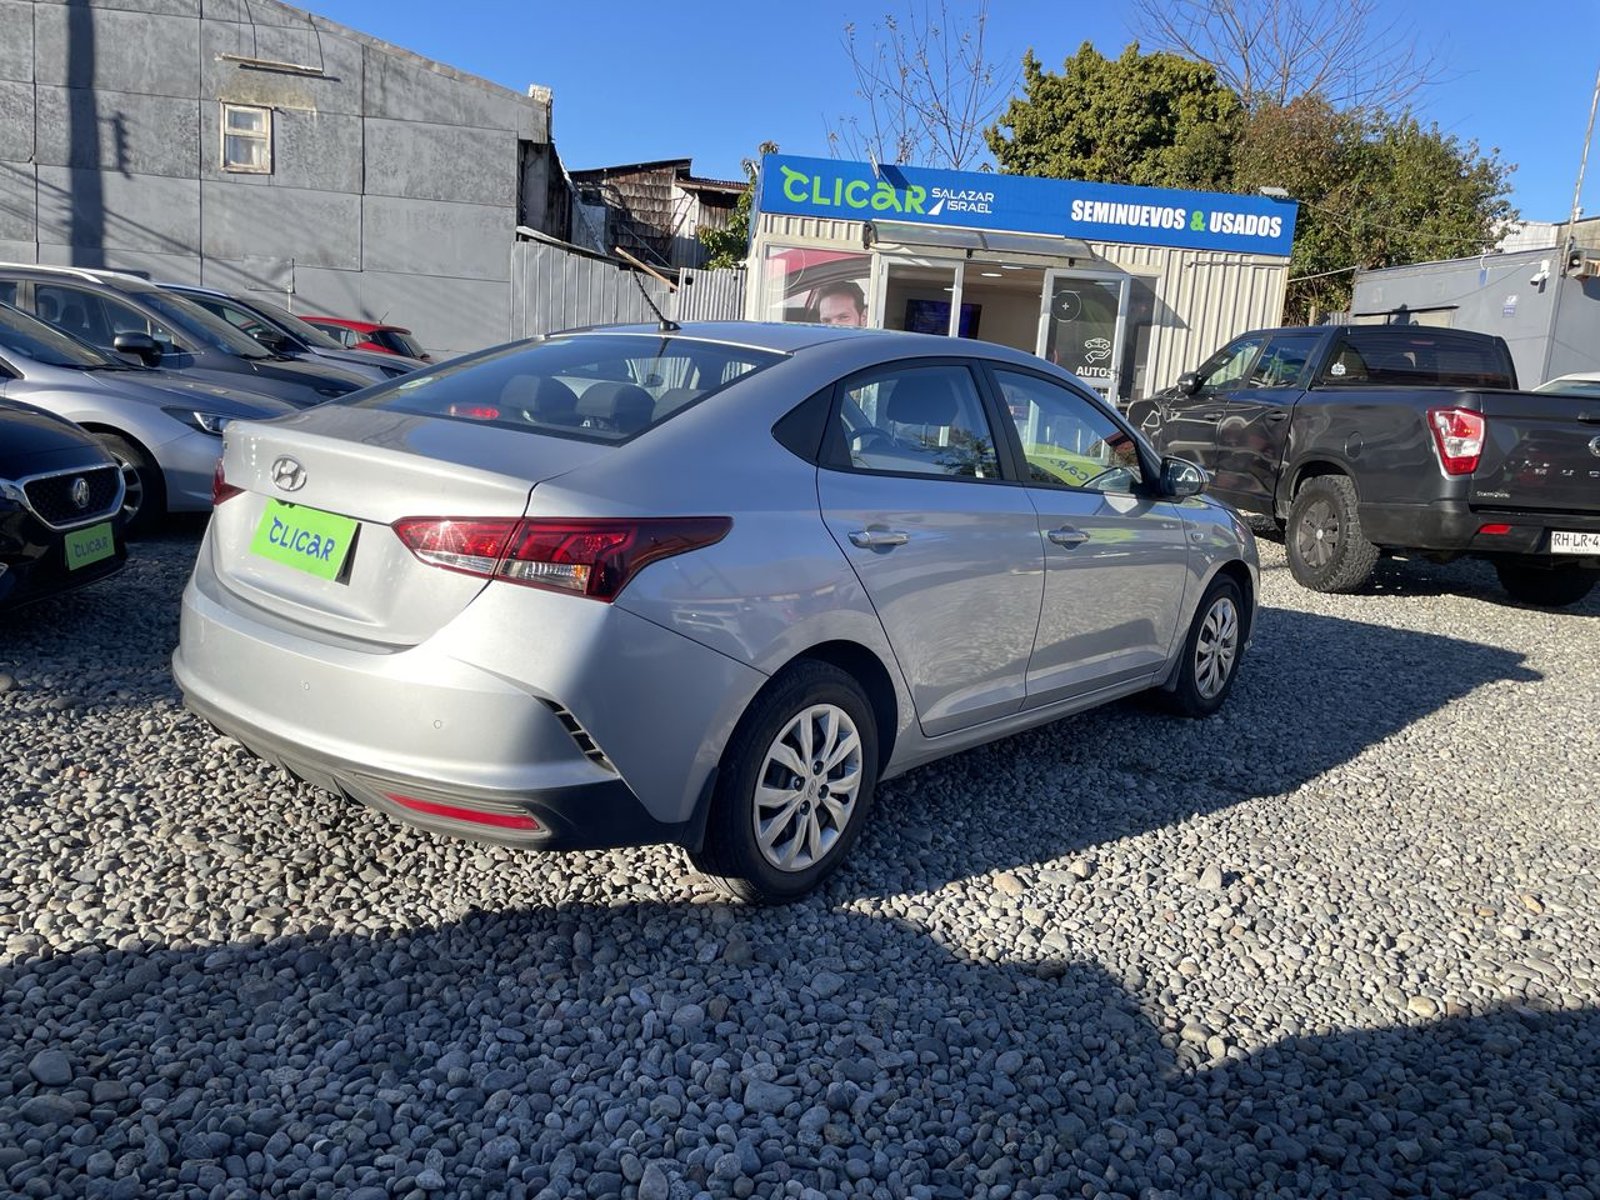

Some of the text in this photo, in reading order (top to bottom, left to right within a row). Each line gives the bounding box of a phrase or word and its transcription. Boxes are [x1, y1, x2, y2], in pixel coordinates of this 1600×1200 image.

[931, 187, 995, 202] SALAZAR
[946, 200, 993, 214] ISRAEL
[1071, 199, 1283, 238] SEMINUEVOS & USADOS
